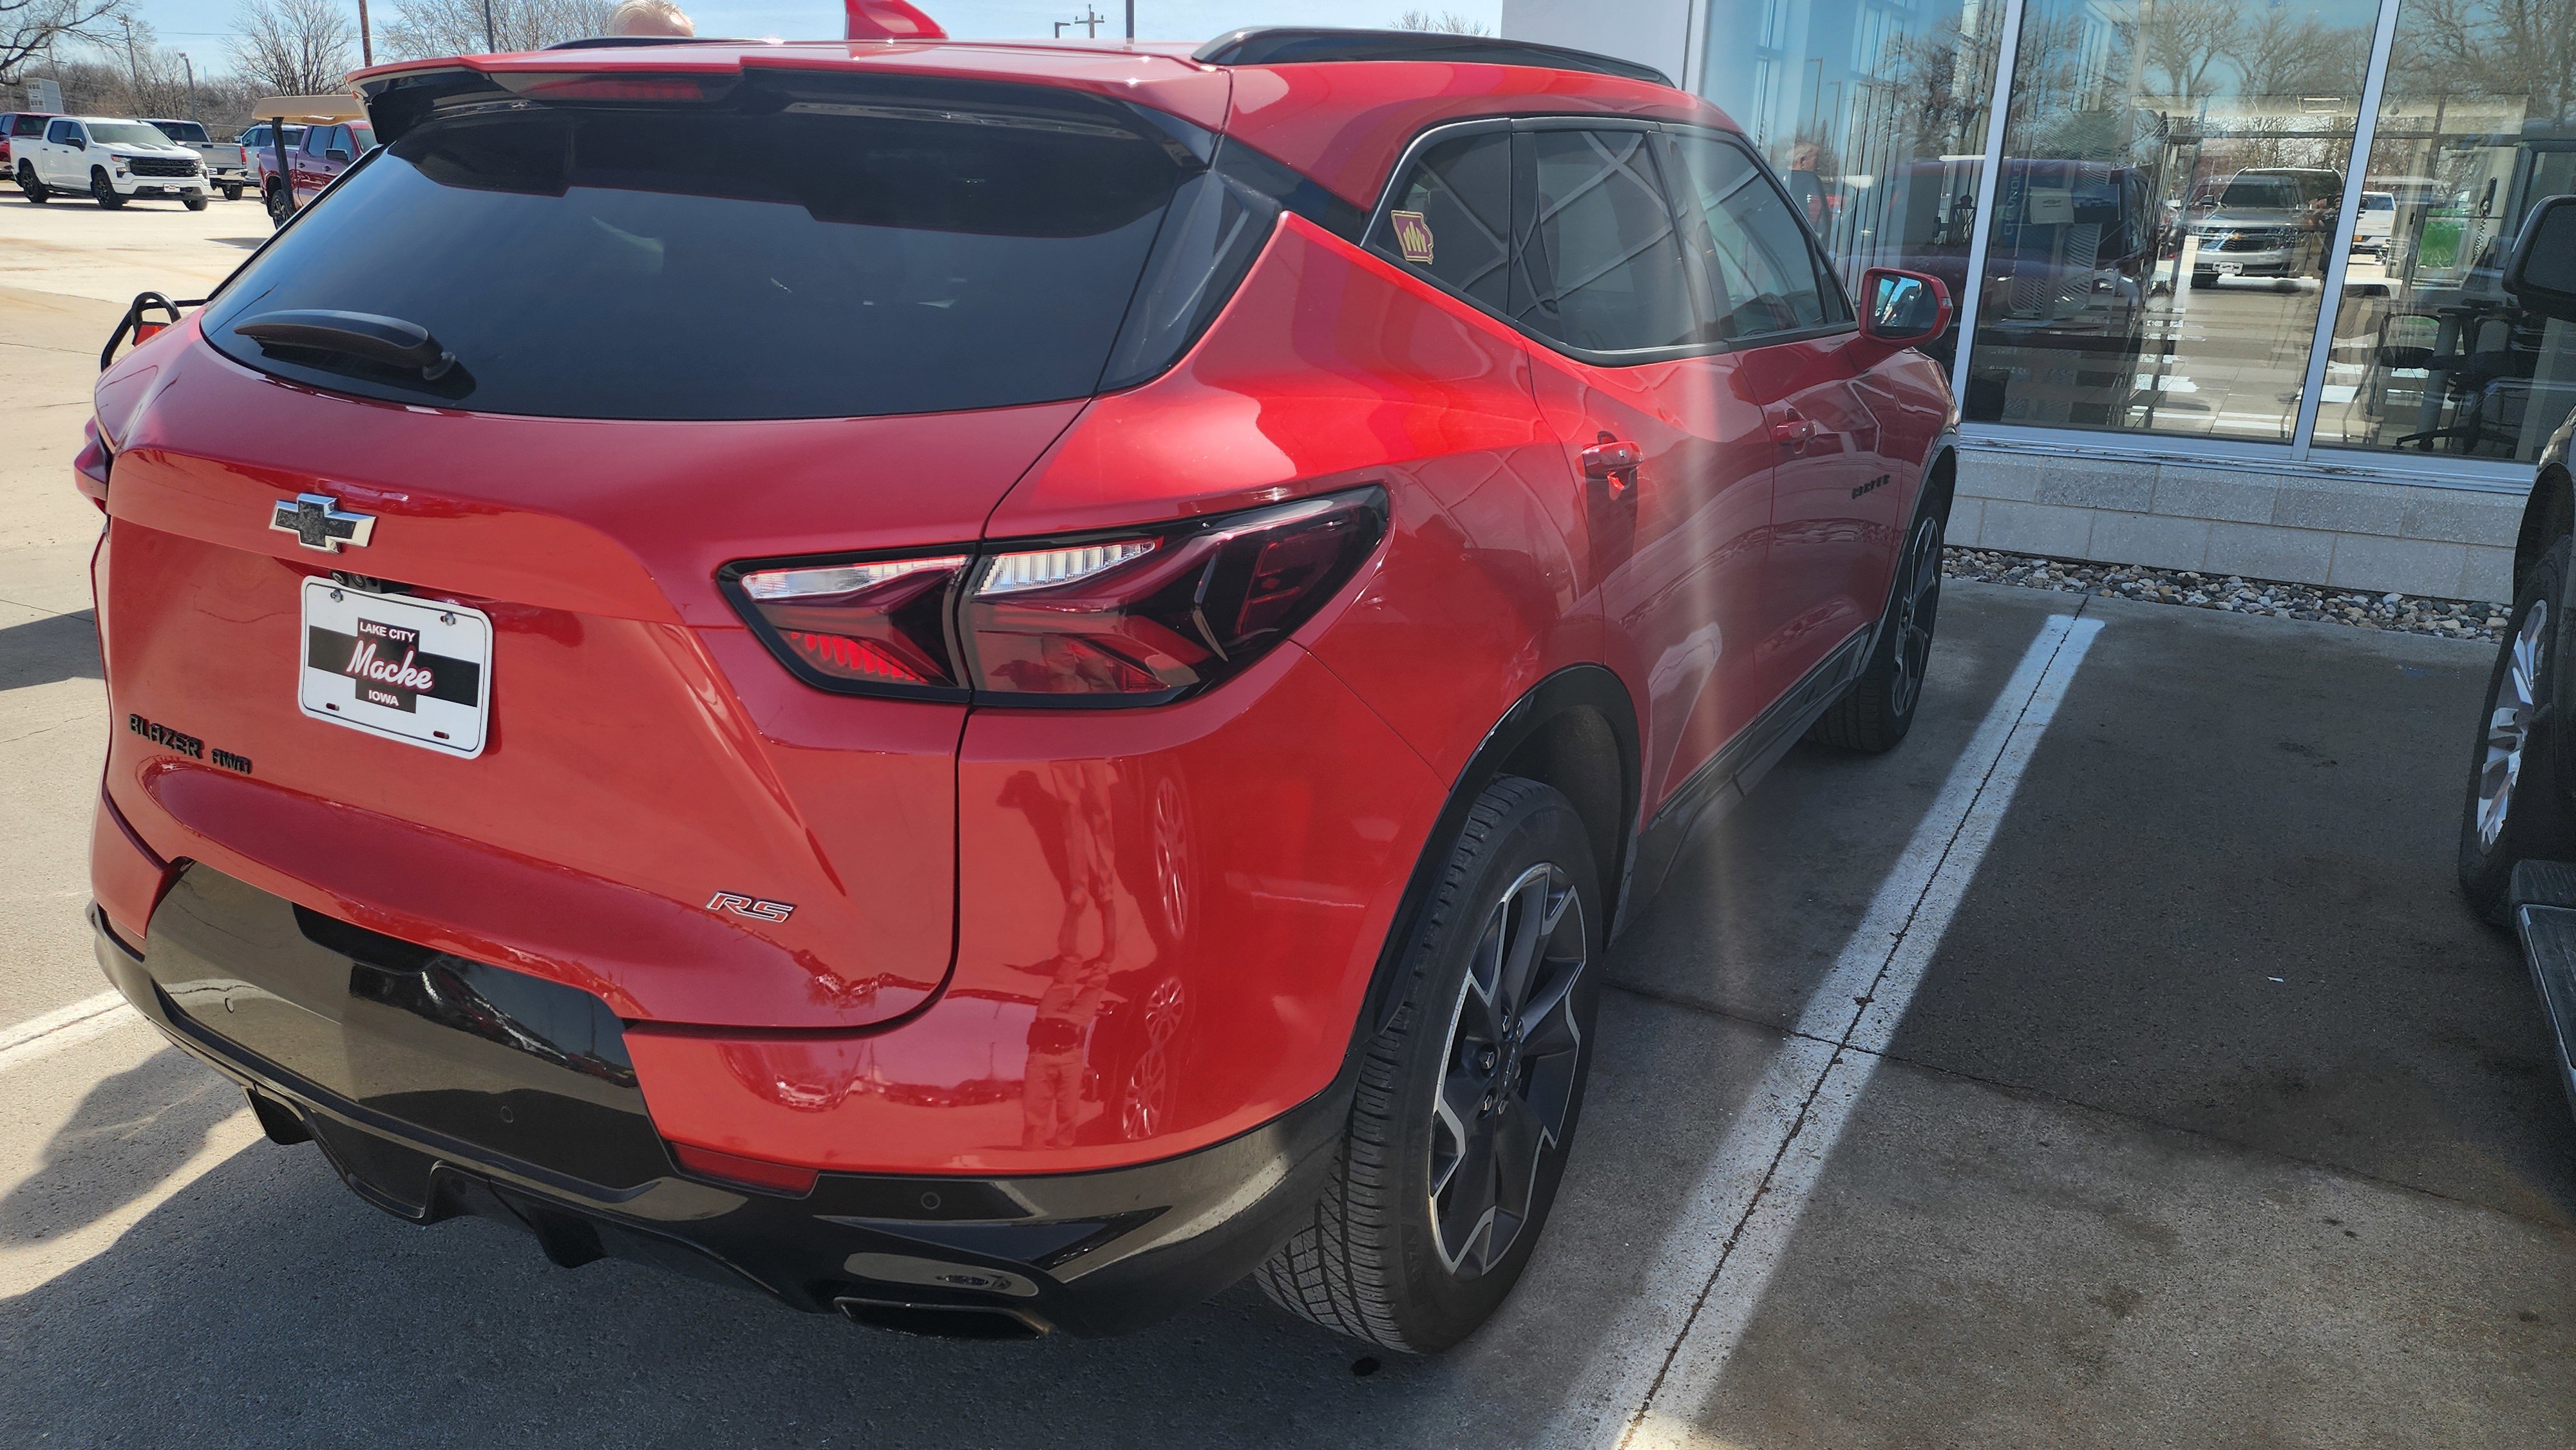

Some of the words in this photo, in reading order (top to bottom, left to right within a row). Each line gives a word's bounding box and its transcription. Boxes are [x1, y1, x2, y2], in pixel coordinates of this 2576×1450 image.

[360, 622, 386, 636] LAKE
[388, 629, 415, 642] CITY
[346, 639, 433, 690] Macke
[368, 690, 399, 706] IOWA
[129, 713, 204, 759] BLAZER
[211, 748, 252, 775] AWD
[706, 891, 795, 923] RS
